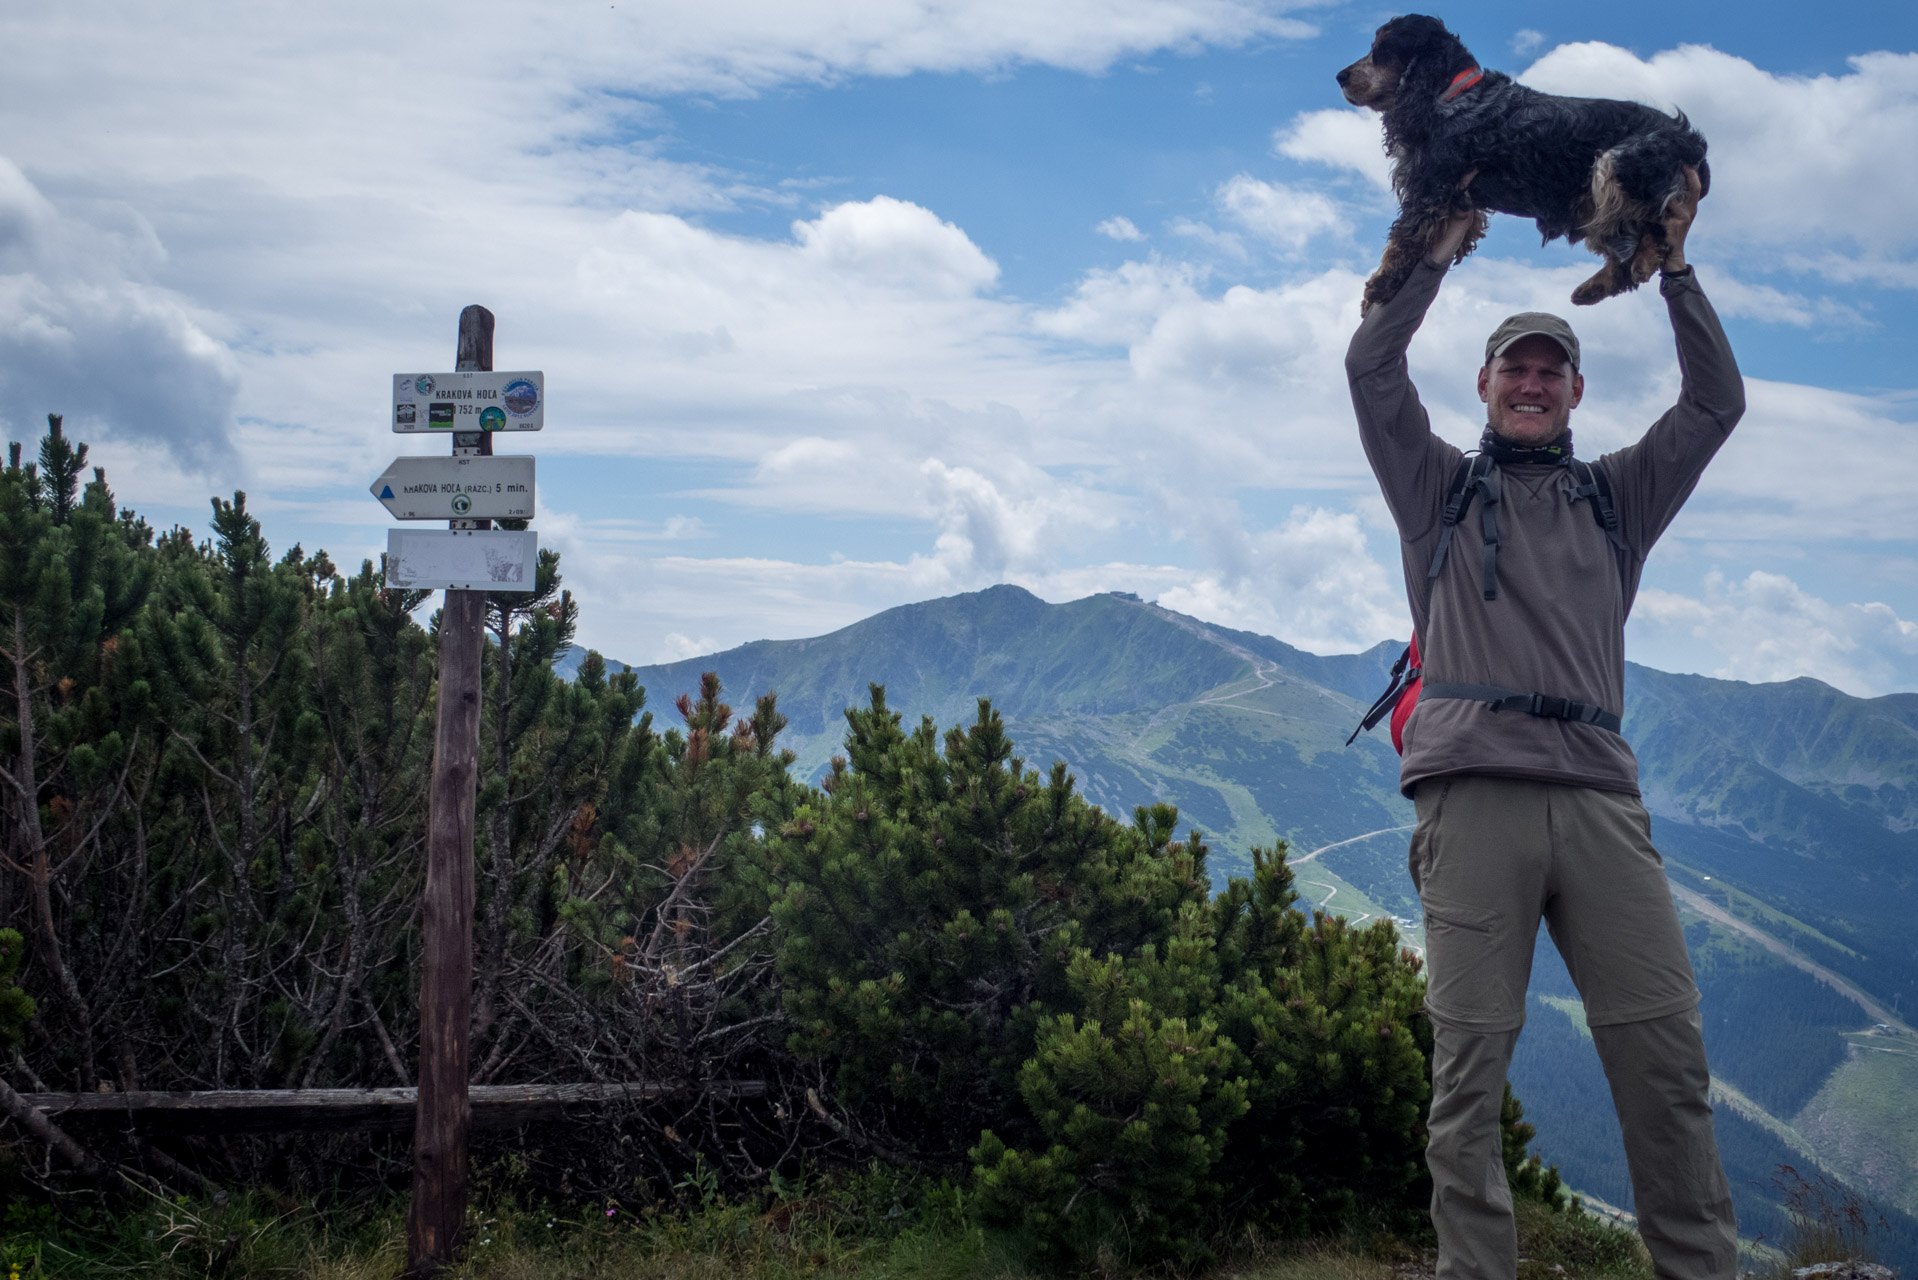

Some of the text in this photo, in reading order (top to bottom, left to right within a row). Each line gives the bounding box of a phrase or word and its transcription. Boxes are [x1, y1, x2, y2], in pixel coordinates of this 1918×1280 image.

[459, 405, 473, 415] 752
[475, 407, 482, 415] m
[496, 483, 502, 493] 5
[507, 483, 528, 493] min.
